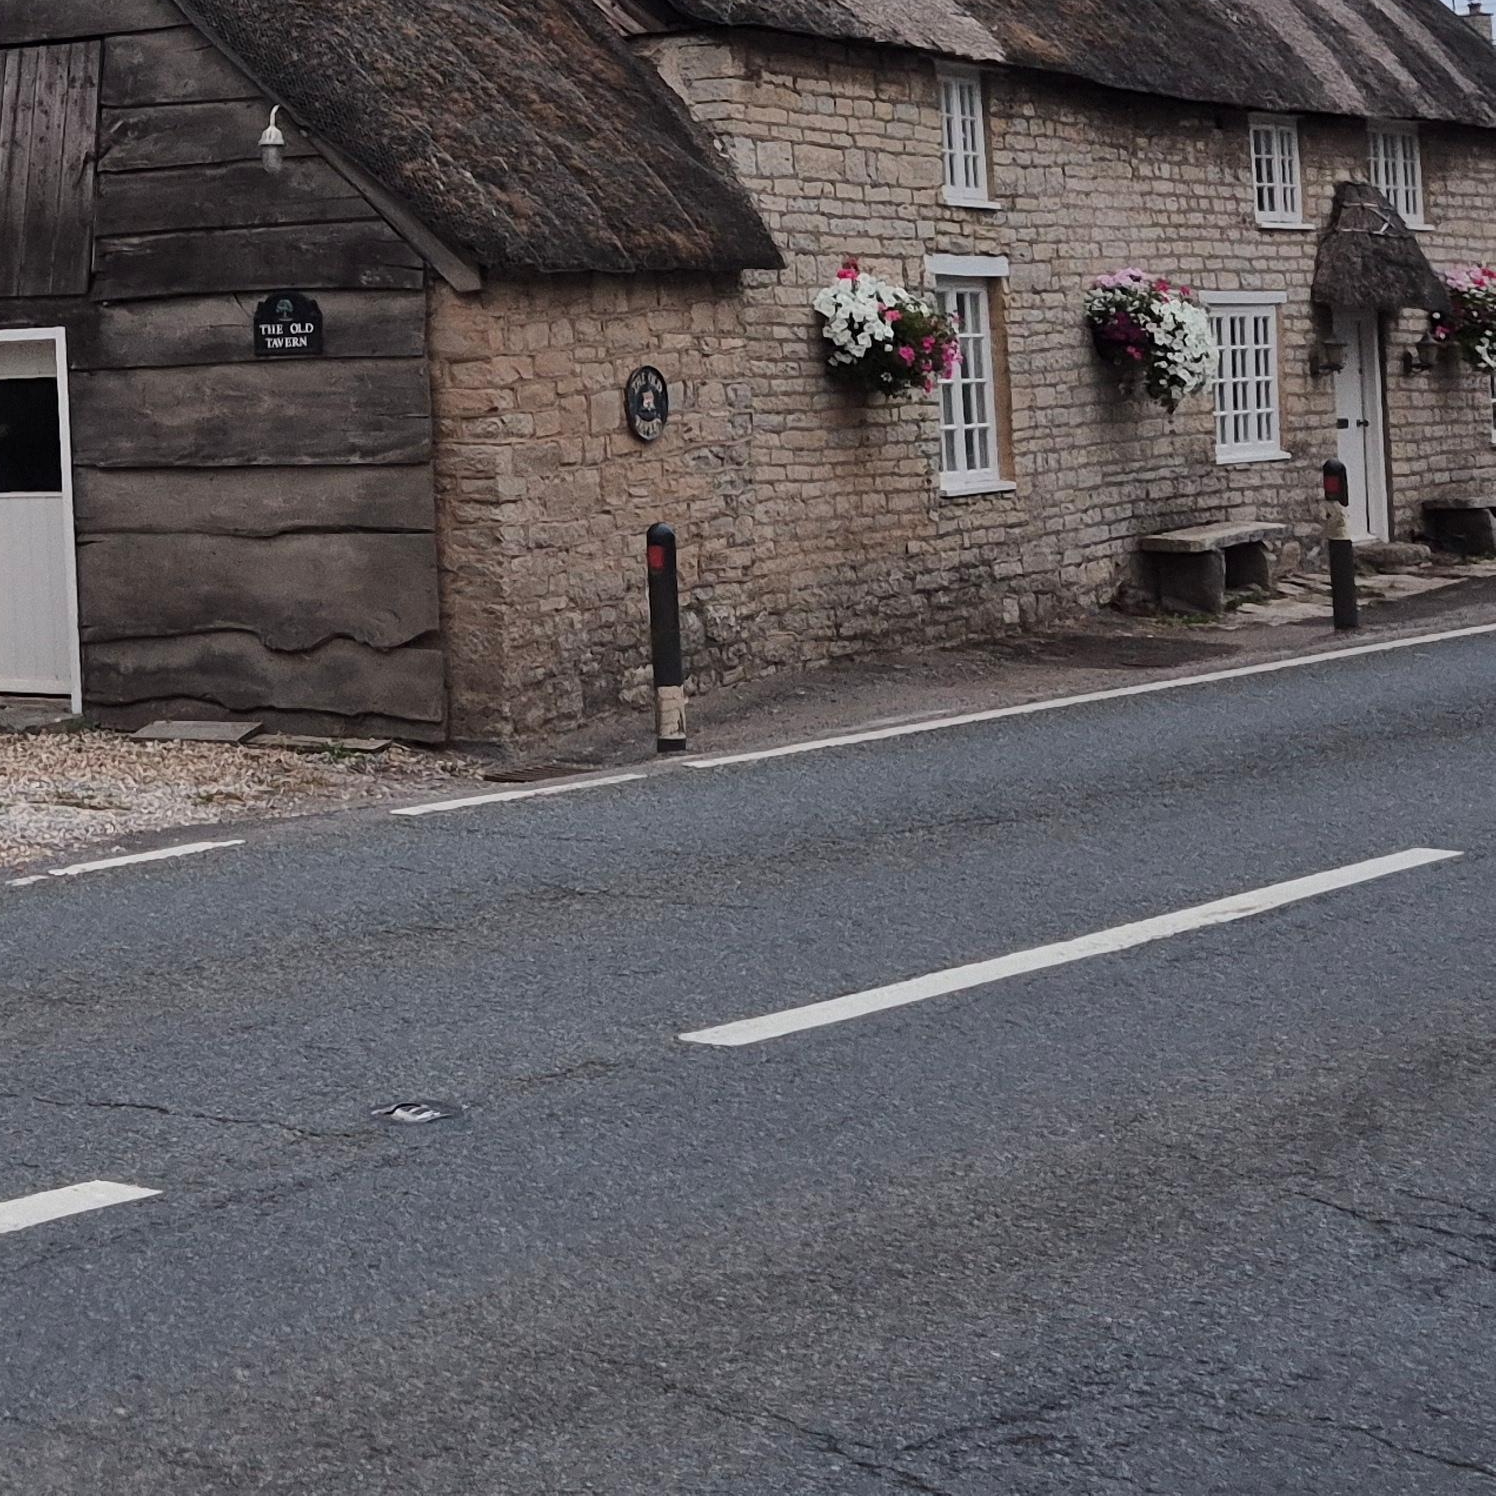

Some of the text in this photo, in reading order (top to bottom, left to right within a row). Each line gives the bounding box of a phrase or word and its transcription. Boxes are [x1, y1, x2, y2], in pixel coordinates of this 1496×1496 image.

[259, 323, 314, 335] THE OLD
[265, 336, 307, 348] TAVERN
